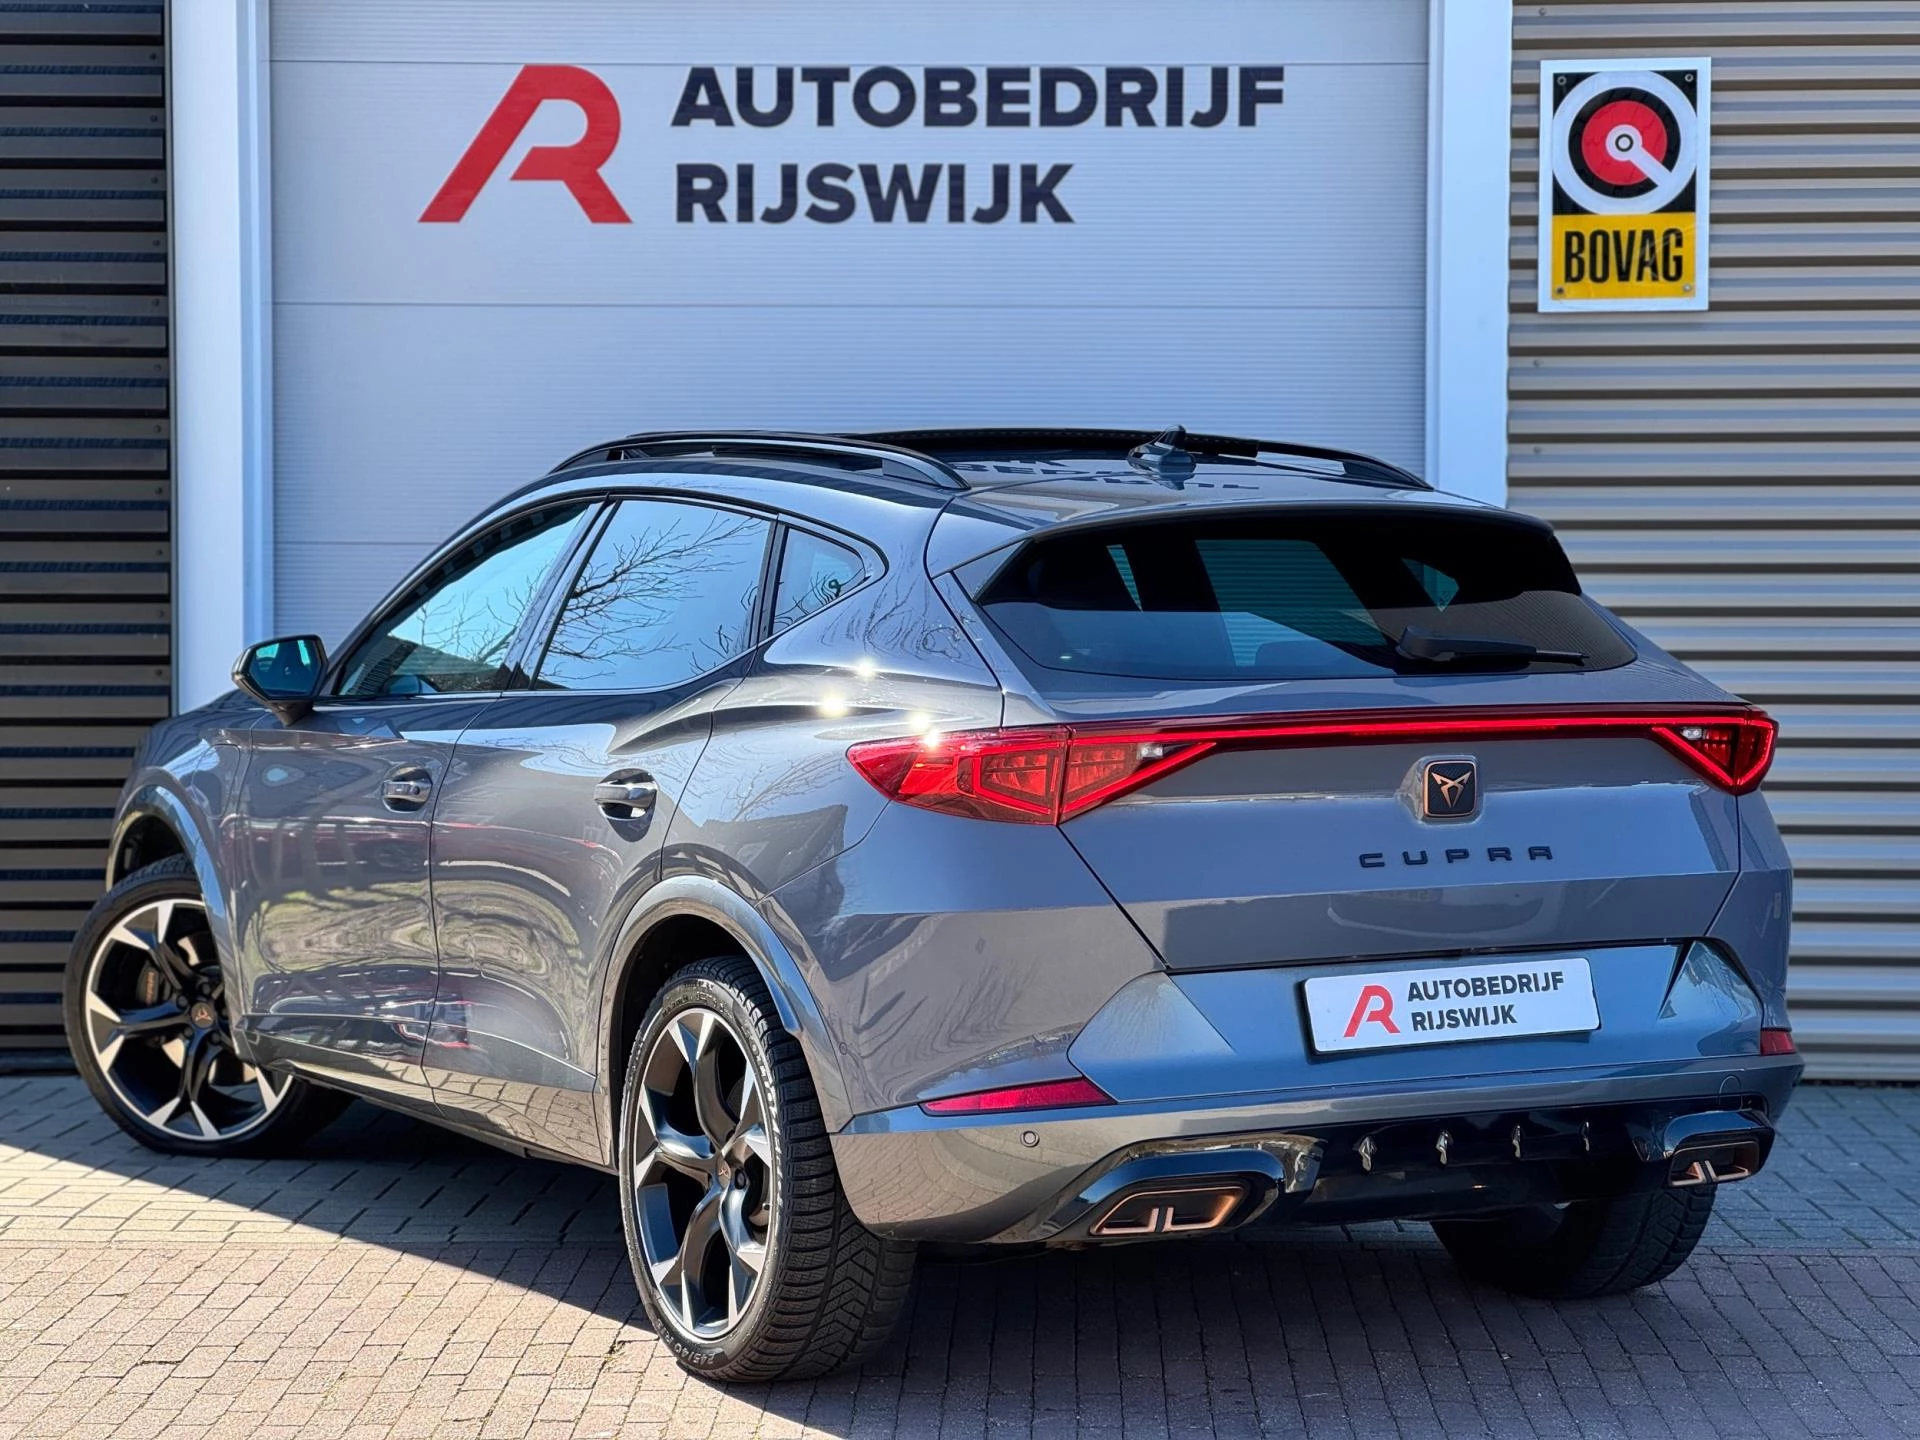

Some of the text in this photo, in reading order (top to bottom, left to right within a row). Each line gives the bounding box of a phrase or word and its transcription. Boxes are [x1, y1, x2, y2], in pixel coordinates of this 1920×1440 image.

[671, 66, 1284, 127] AUTOBEDRIJF
[677, 163, 1073, 224] RIJSWIJK
[1565, 228, 1682, 283] BOVAG
[1359, 846, 1553, 868] CUPRA
[1408, 971, 1564, 1002] AUTOBEDRIJF
[1412, 1004, 1518, 1032] RIJSWIJK
